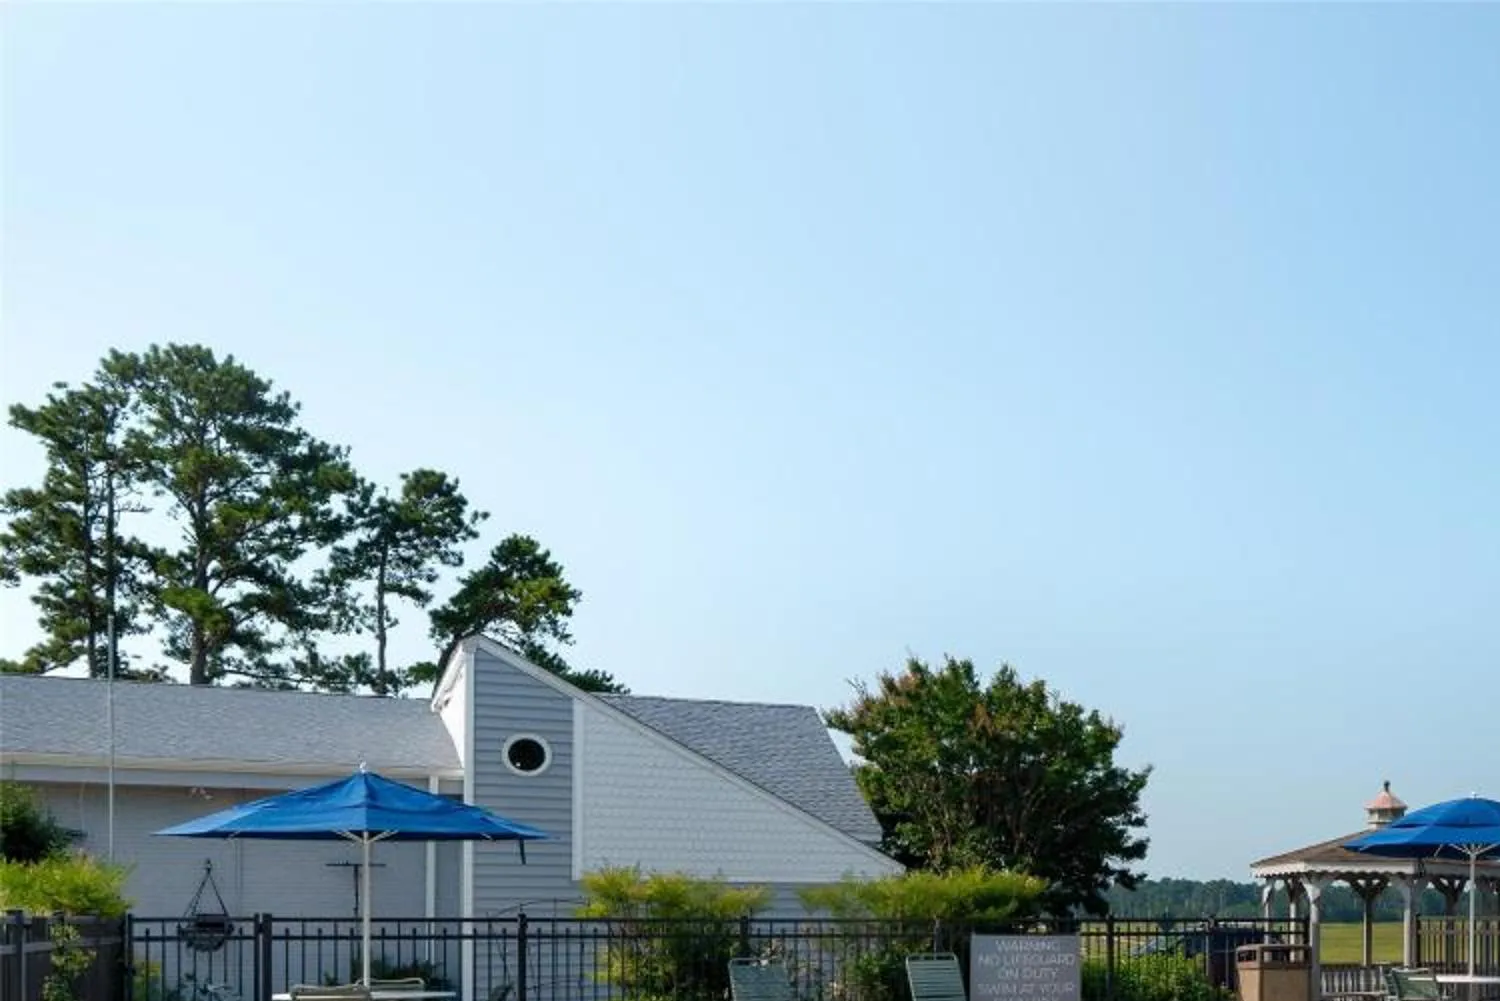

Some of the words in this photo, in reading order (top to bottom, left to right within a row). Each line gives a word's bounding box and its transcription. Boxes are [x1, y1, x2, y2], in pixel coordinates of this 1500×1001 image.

[996, 939, 1060, 953] WARNING
[978, 954, 1001, 966] NO
[1004, 953, 1075, 967] LIFEGUARD
[998, 967, 1019, 980] ON
[1022, 967, 1059, 979] DUTY
[977, 983, 1017, 996] SWIM
